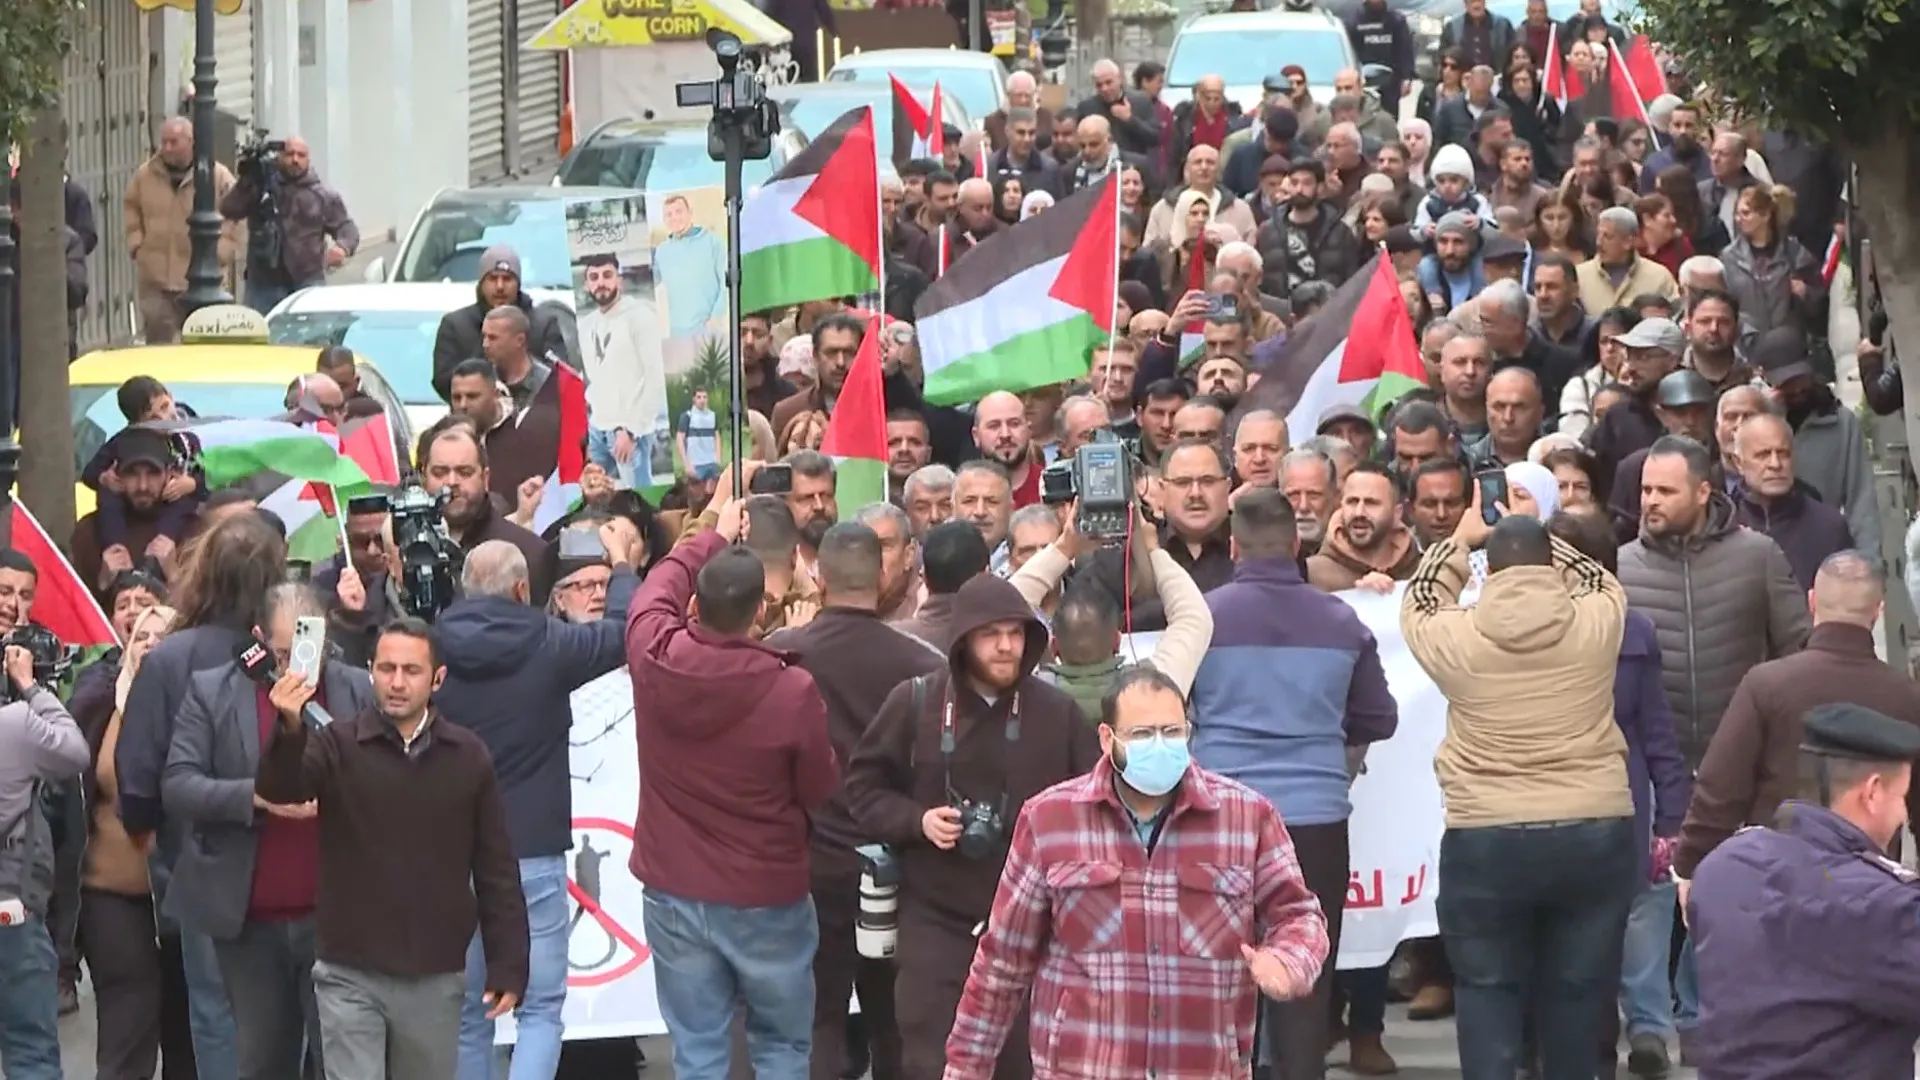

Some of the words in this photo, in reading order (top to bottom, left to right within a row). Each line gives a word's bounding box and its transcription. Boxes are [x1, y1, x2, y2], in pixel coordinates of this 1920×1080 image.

[649, 16, 700, 34] CORN
[240, 642, 262, 661] TRT
[1400, 863, 1426, 906] لا
